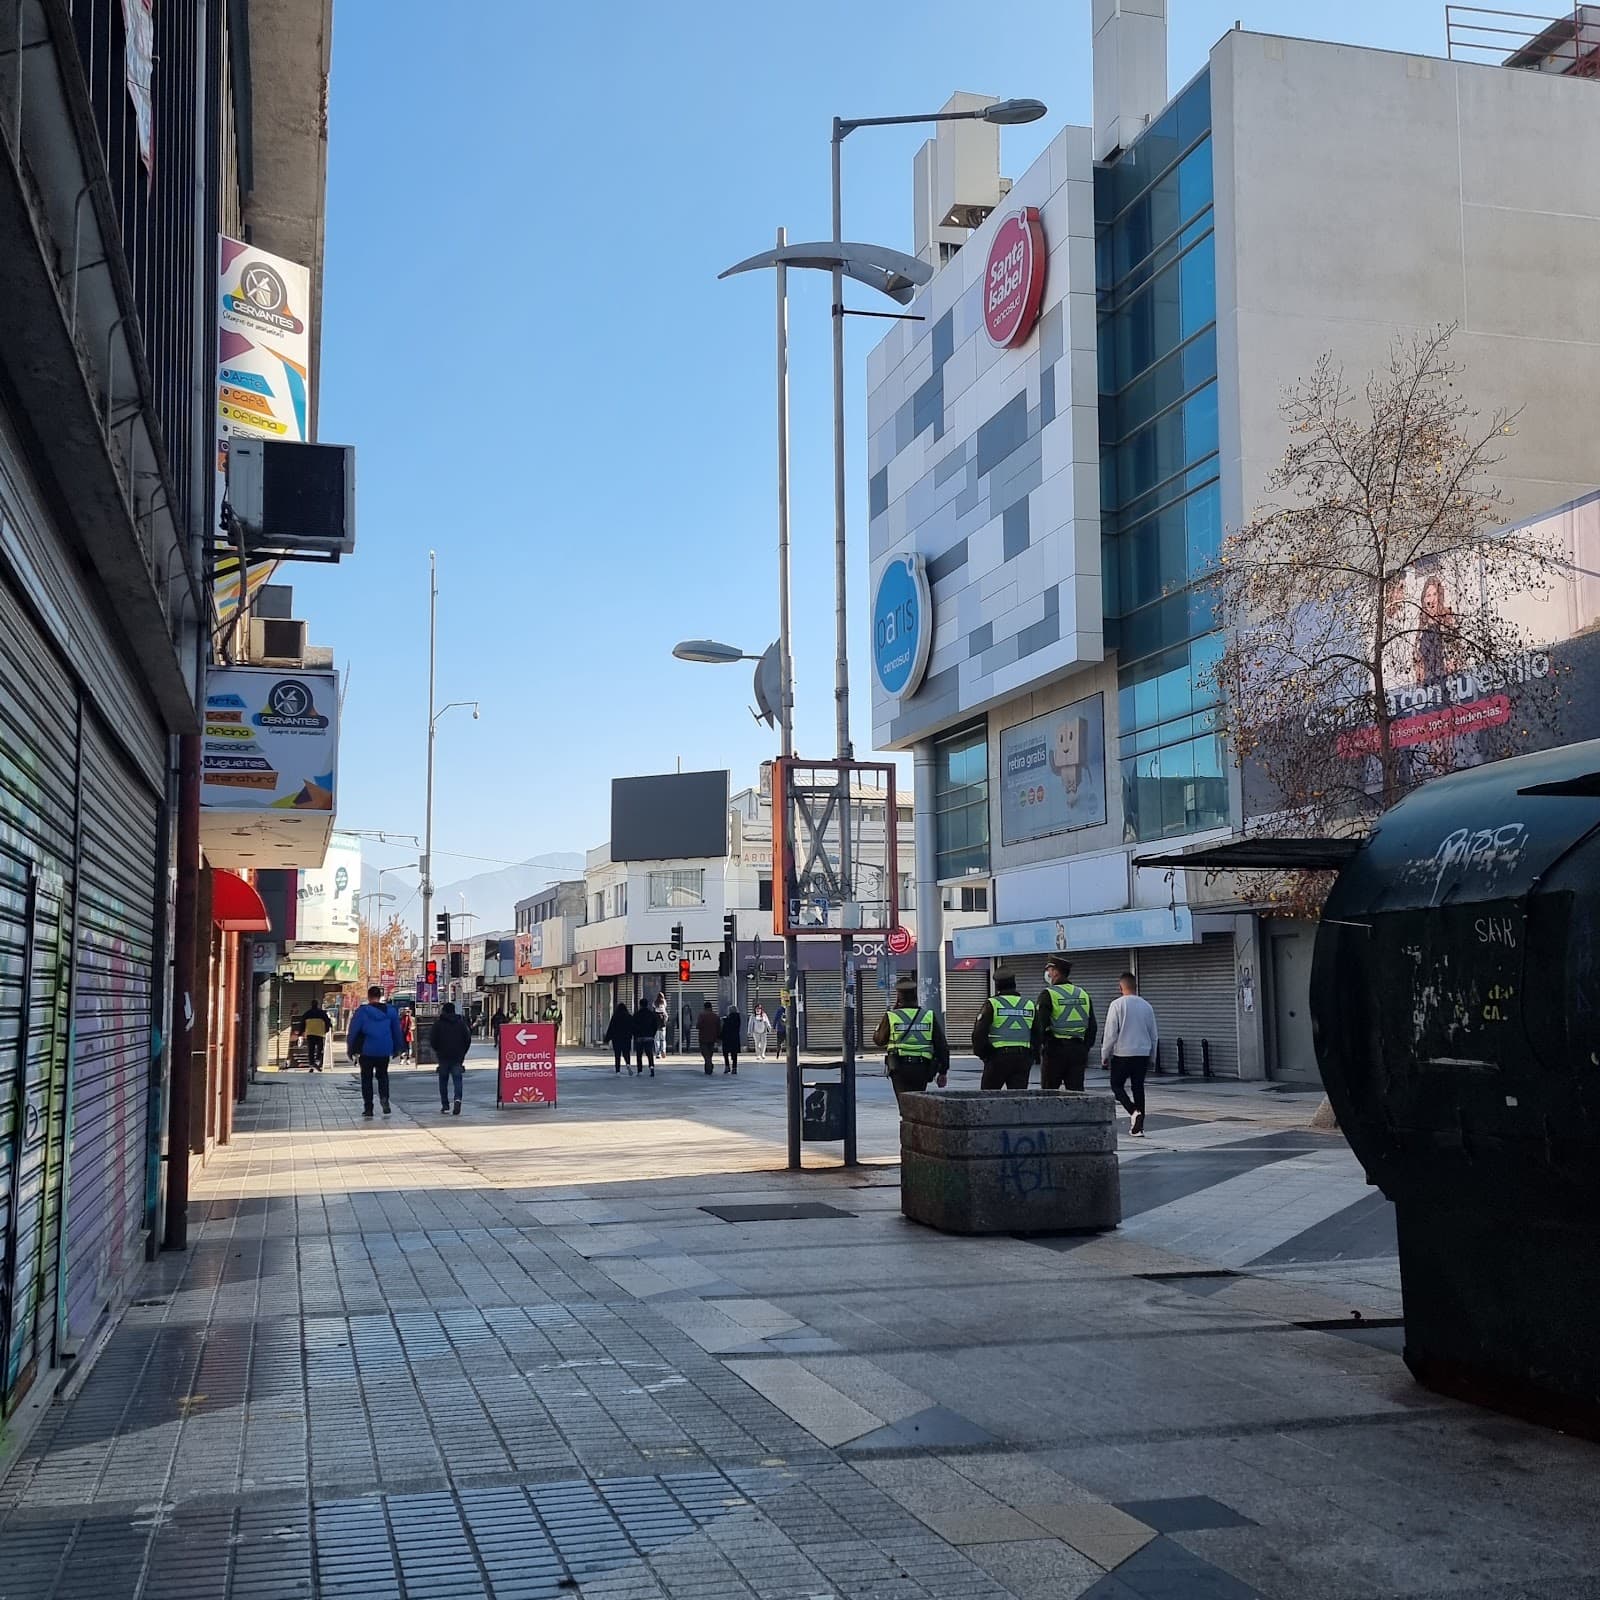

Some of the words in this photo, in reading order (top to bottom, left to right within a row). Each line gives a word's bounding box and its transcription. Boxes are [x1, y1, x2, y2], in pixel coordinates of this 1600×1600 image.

[990, 240, 1024, 288] Santa
[988, 257, 1023, 313] Isabel
[233, 300, 294, 329] CERVANTES
[993, 293, 1021, 328] cencosud
[231, 371, 263, 388] Arte
[233, 409, 277, 429] Oficina
[878, 599, 914, 659] paris
[883, 647, 910, 674] cencosud
[1401, 683, 1442, 712] con
[1446, 674, 1473, 702] tu
[206, 726, 249, 736] Oficina
[261, 716, 320, 726] CERVANTES
[205, 741, 256, 752] Escolar
[205, 758, 266, 768] Juguetes
[1008, 755, 1026, 772] retira
[1026, 748, 1046, 768] gratis
[646, 950, 664, 962] LA
[668, 949, 712, 961] GTITA
[505, 1061, 552, 1071] ABIERTO
[517, 1051, 551, 1061] preunic
